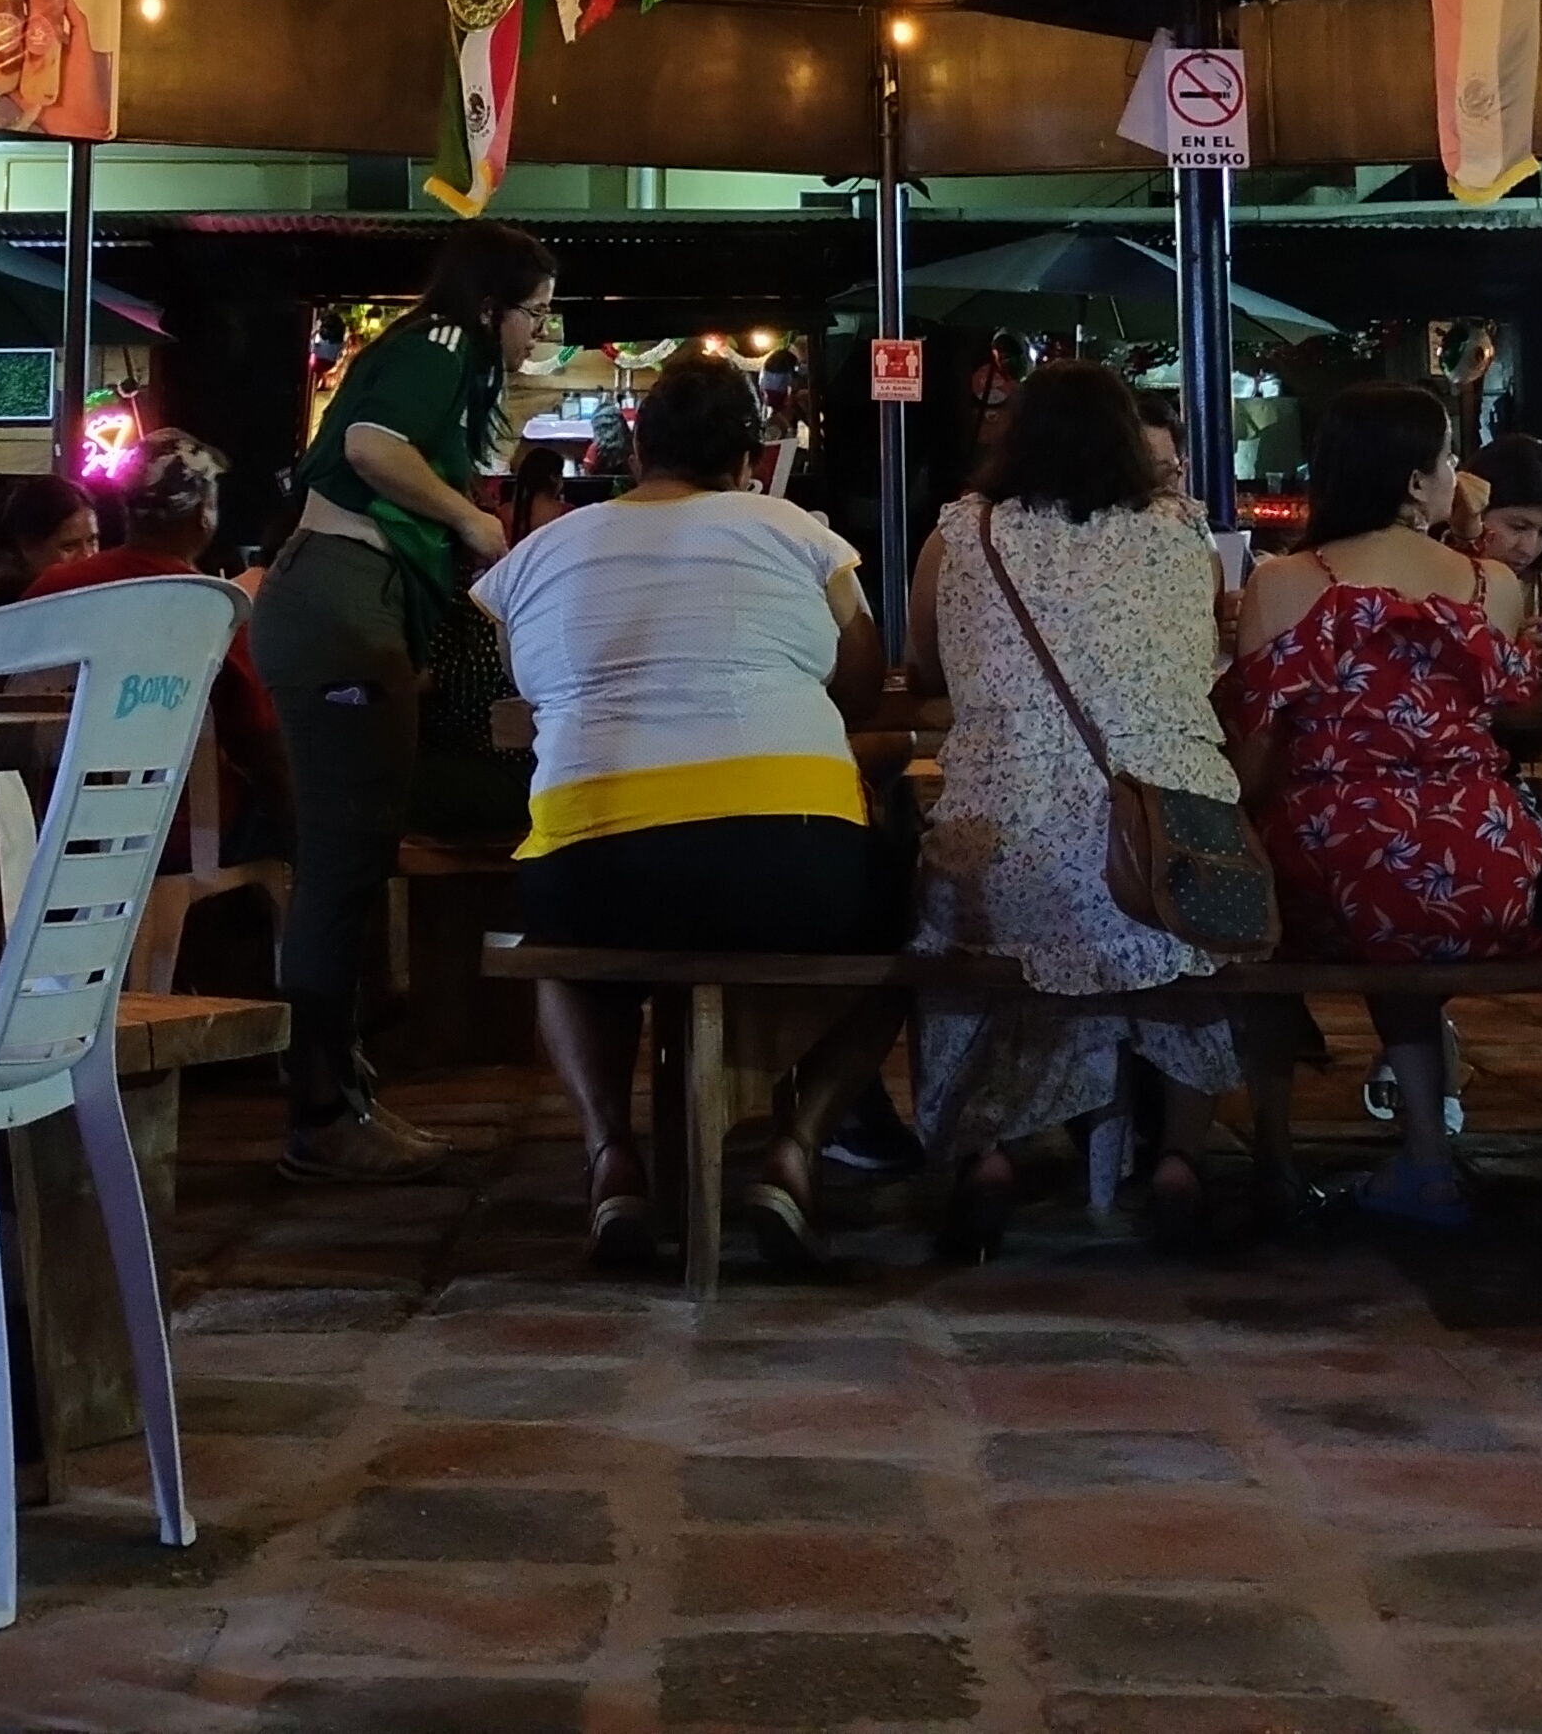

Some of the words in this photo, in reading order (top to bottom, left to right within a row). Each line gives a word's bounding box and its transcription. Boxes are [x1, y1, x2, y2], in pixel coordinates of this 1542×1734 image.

[1181, 135, 1206, 148] EN
[1213, 135, 1236, 148] EL
[1172, 152, 1245, 165] KIOSKO
